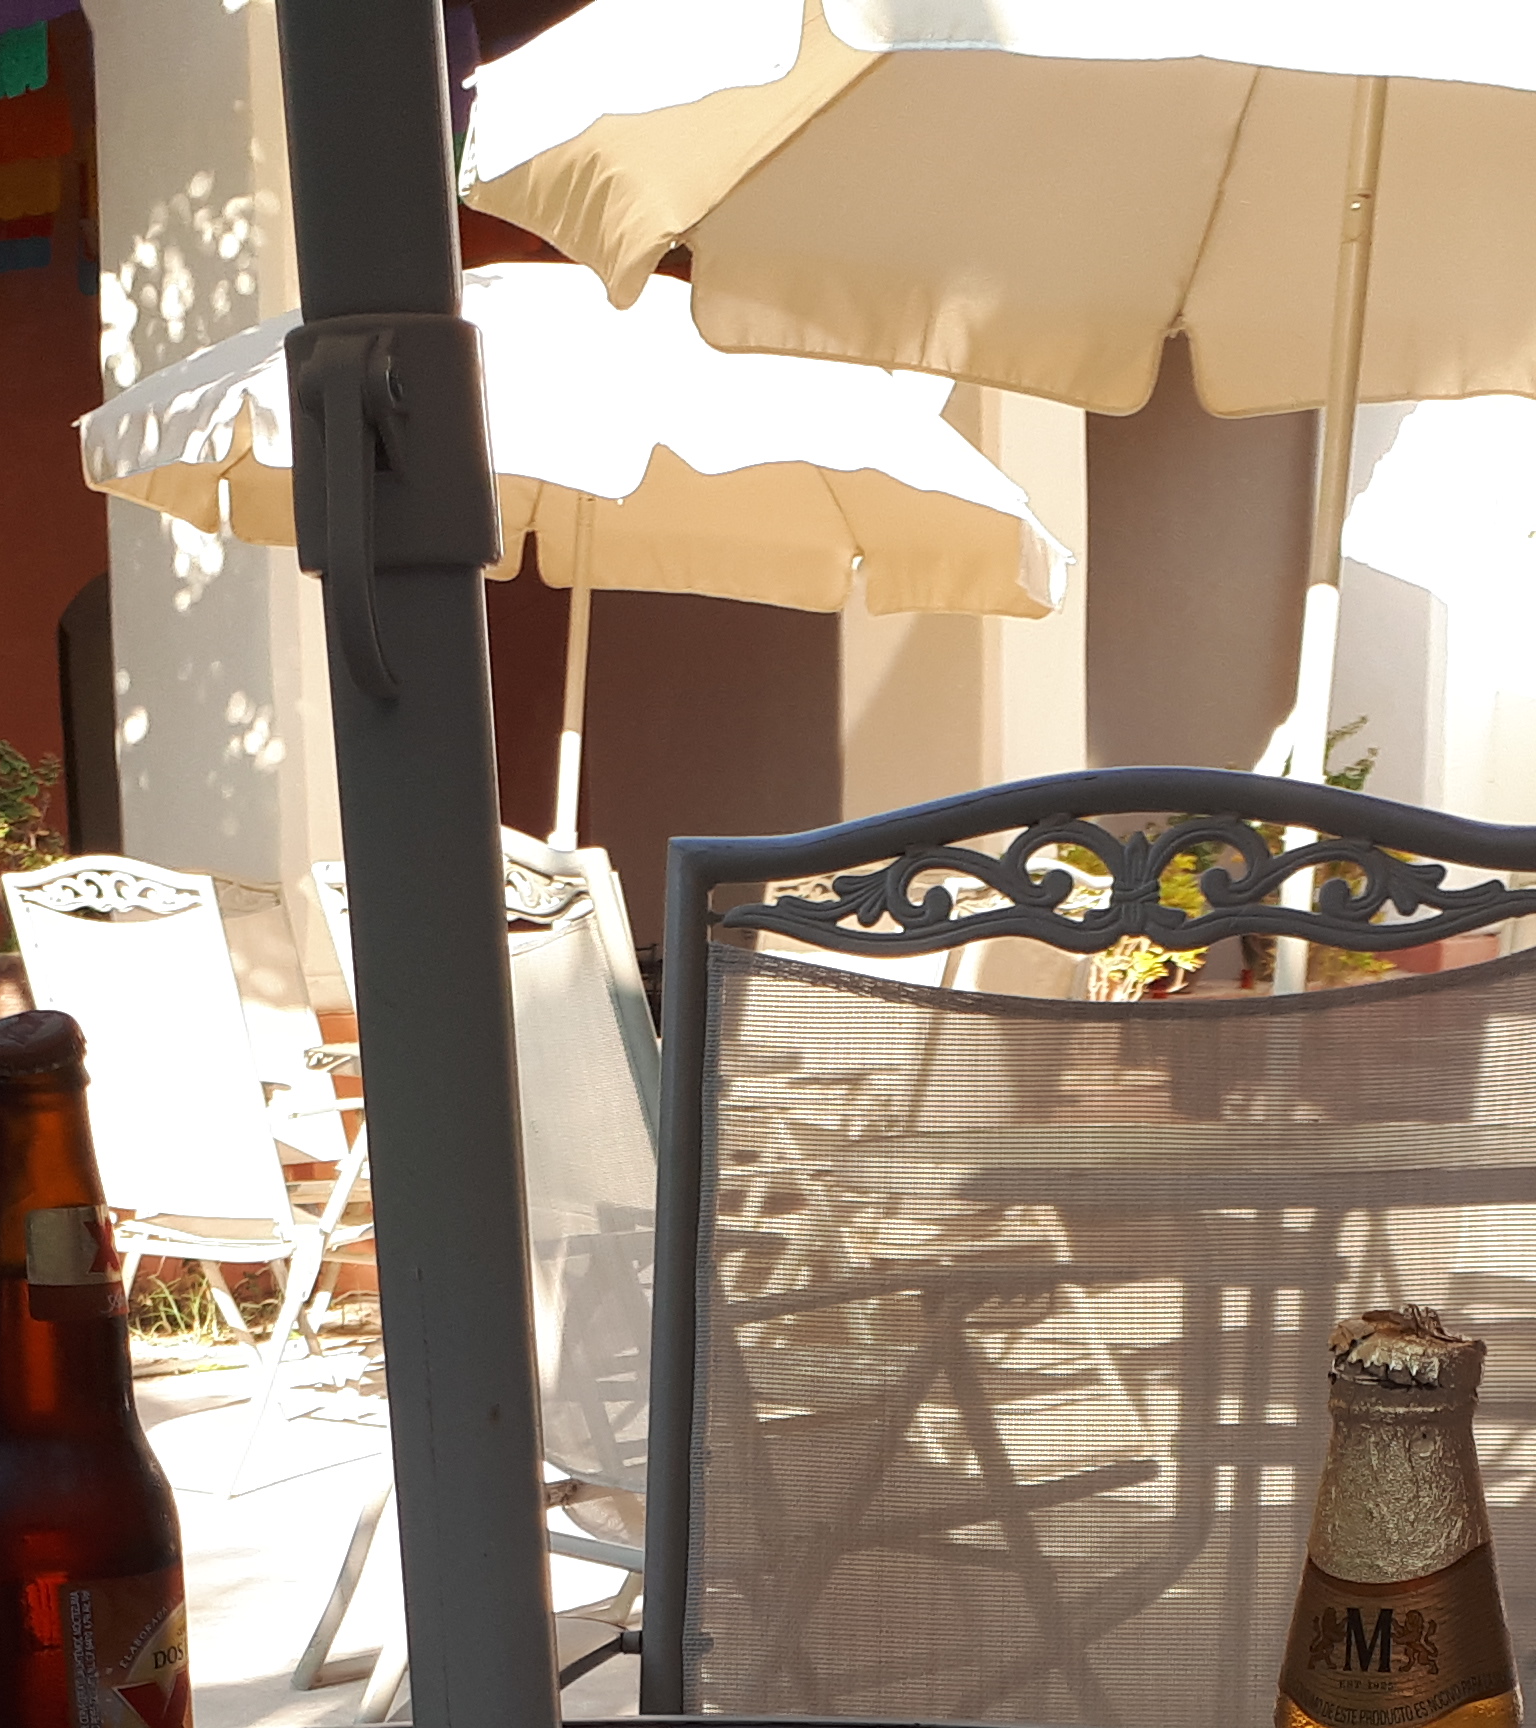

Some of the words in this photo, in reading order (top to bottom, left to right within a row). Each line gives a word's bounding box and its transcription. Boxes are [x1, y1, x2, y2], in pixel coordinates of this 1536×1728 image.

[1343, 1607, 1394, 1673] M
[153, 1643, 184, 1669] DOS
[1334, 1705, 1358, 1725] ESTE
[1359, 1706, 1413, 1726] PRODUCTO
[1414, 1699, 1429, 1719] ES
